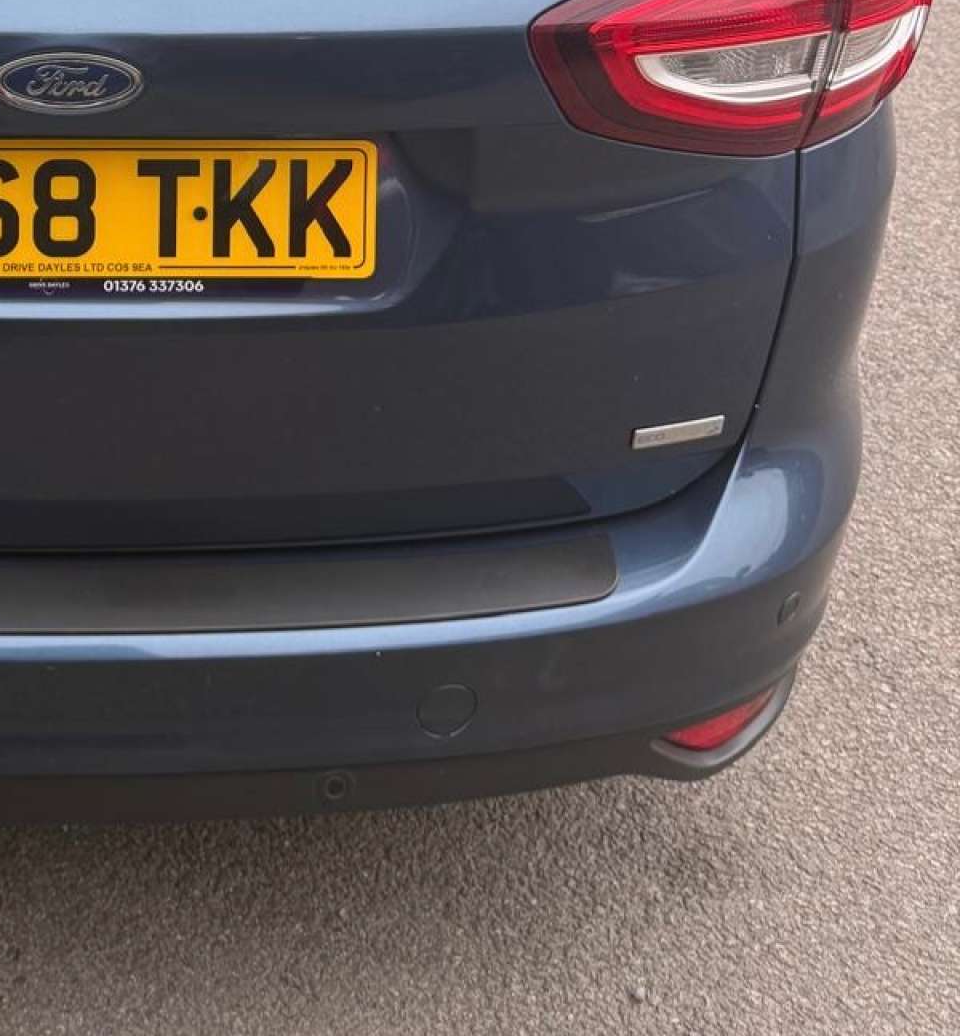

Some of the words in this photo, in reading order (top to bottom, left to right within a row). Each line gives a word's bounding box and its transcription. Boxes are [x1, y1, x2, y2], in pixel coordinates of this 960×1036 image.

[25, 65, 109, 97] Ford
[137, 158, 353, 258] TKK
[2, 263, 34, 272] DRIVE
[37, 263, 80, 272] DAYLES
[83, 263, 104, 272] LTD
[103, 280, 146, 293] 01376
[149, 280, 204, 293] 337306
